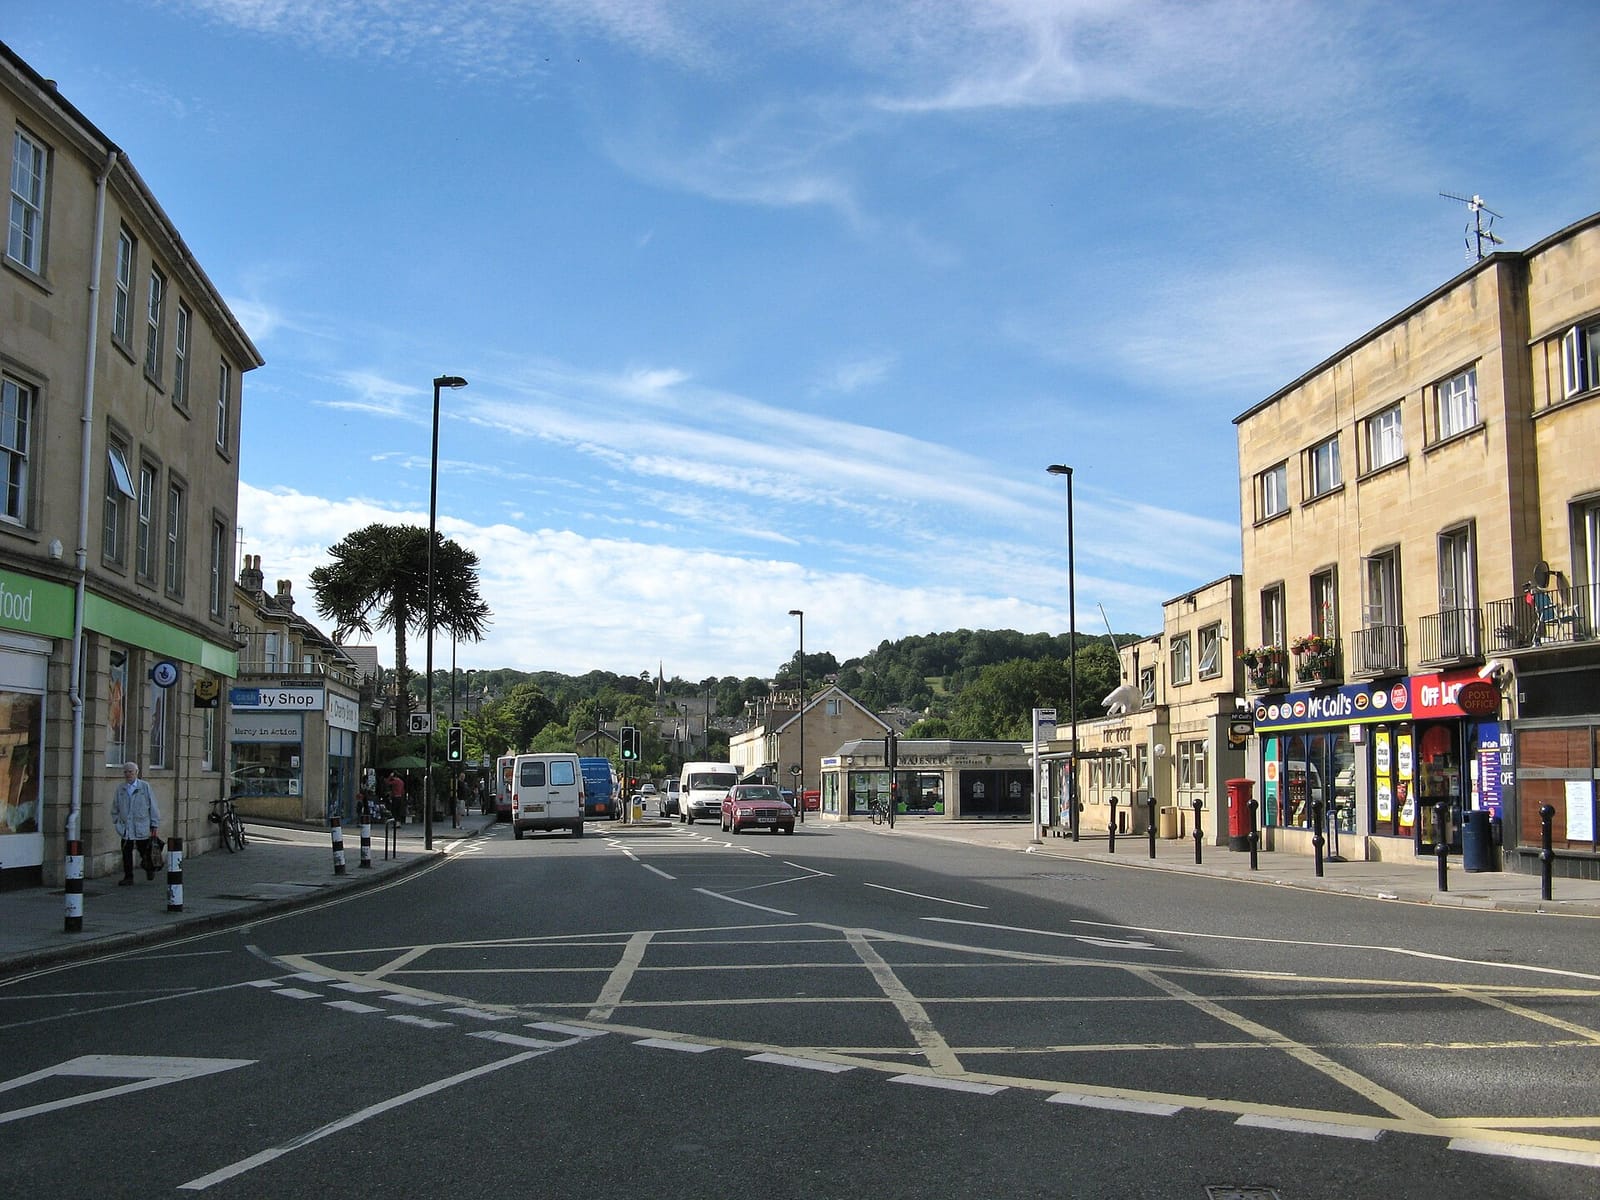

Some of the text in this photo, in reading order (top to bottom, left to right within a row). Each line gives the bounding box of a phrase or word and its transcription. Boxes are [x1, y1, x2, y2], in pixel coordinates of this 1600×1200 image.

[0, 582, 33, 623] food
[259, 693, 314, 707] ity Shop
[1468, 690, 1491, 700] POST
[1307, 693, 1352, 719] McColl's
[1464, 700, 1494, 709] OFFICE
[234, 727, 298, 736] Mercy in Action
[898, 755, 948, 766] MAJESTIC
[1500, 772, 1514, 786] OPE
